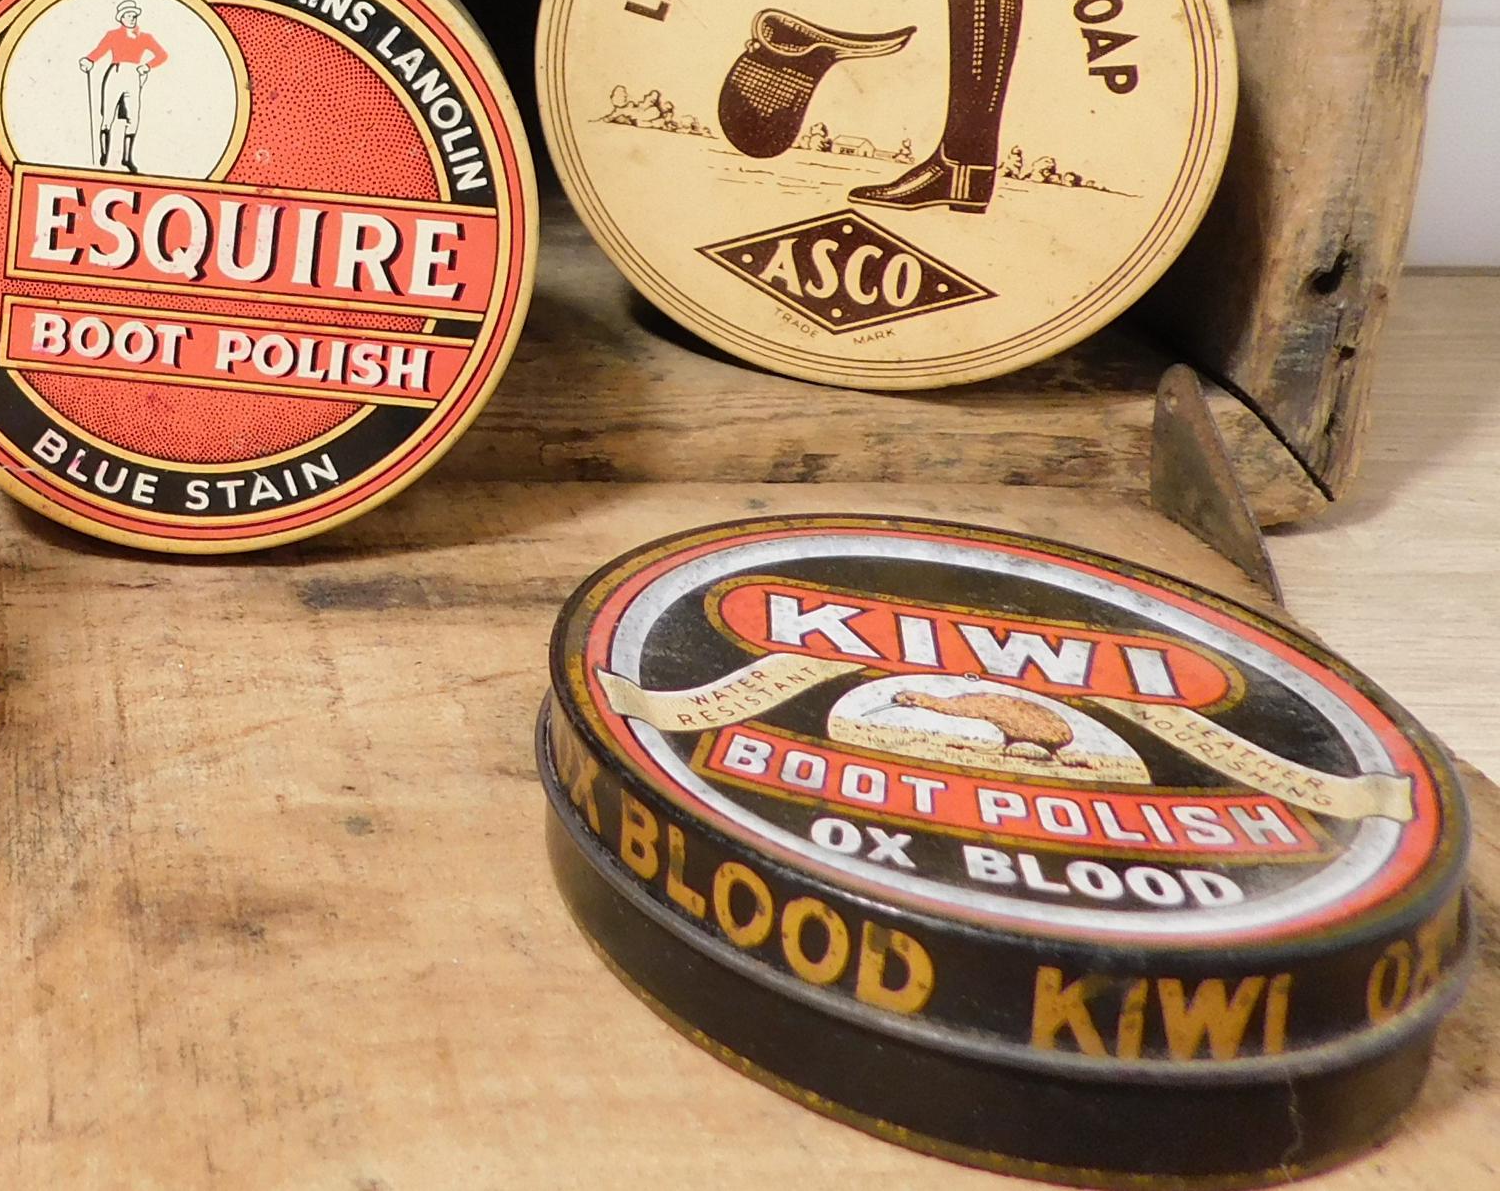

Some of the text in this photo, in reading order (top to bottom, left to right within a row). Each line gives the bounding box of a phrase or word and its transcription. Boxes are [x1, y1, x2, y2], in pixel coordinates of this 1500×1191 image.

[377, 27, 488, 193] LANOLIN
[29, 183, 468, 302] ESQUIRE
[758, 237, 923, 308] ASCO
[32, 312, 432, 394] BOOT POLISH
[772, 307, 896, 346] TRADE MARK
[32, 428, 341, 511] BLUE STAIN
[689, 668, 768, 706] WATER
[765, 591, 1183, 699] KIWI
[678, 665, 817, 727] RESISTANT
[722, 733, 1300, 846] BOOT POLISH
[1135, 708, 1334, 807] NOURISHING
[1184, 717, 1325, 791] LEATHER
[811, 818, 1245, 907] OX BLOOD
[619, 788, 1293, 1061] BLOOD KIWI
